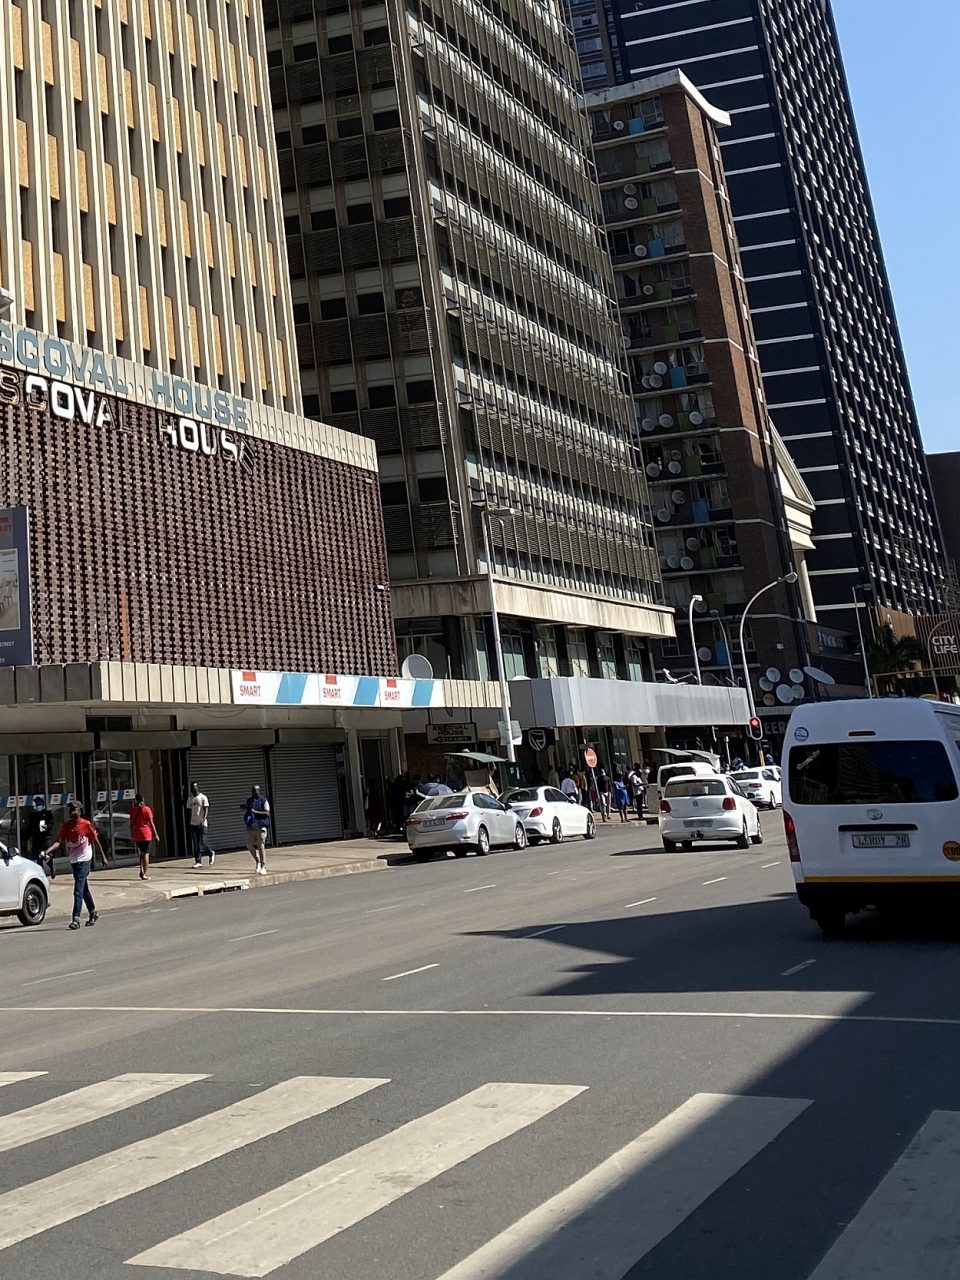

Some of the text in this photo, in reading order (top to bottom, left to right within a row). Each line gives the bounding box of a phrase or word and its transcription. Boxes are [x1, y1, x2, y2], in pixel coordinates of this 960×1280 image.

[151, 370, 249, 431] HOUSE
[932, 635, 956, 646] CITY
[934, 644, 958, 654] LIFE
[239, 685, 261, 697] SMART
[323, 688, 341, 699] SMART
[384, 690, 401, 701] SMART
